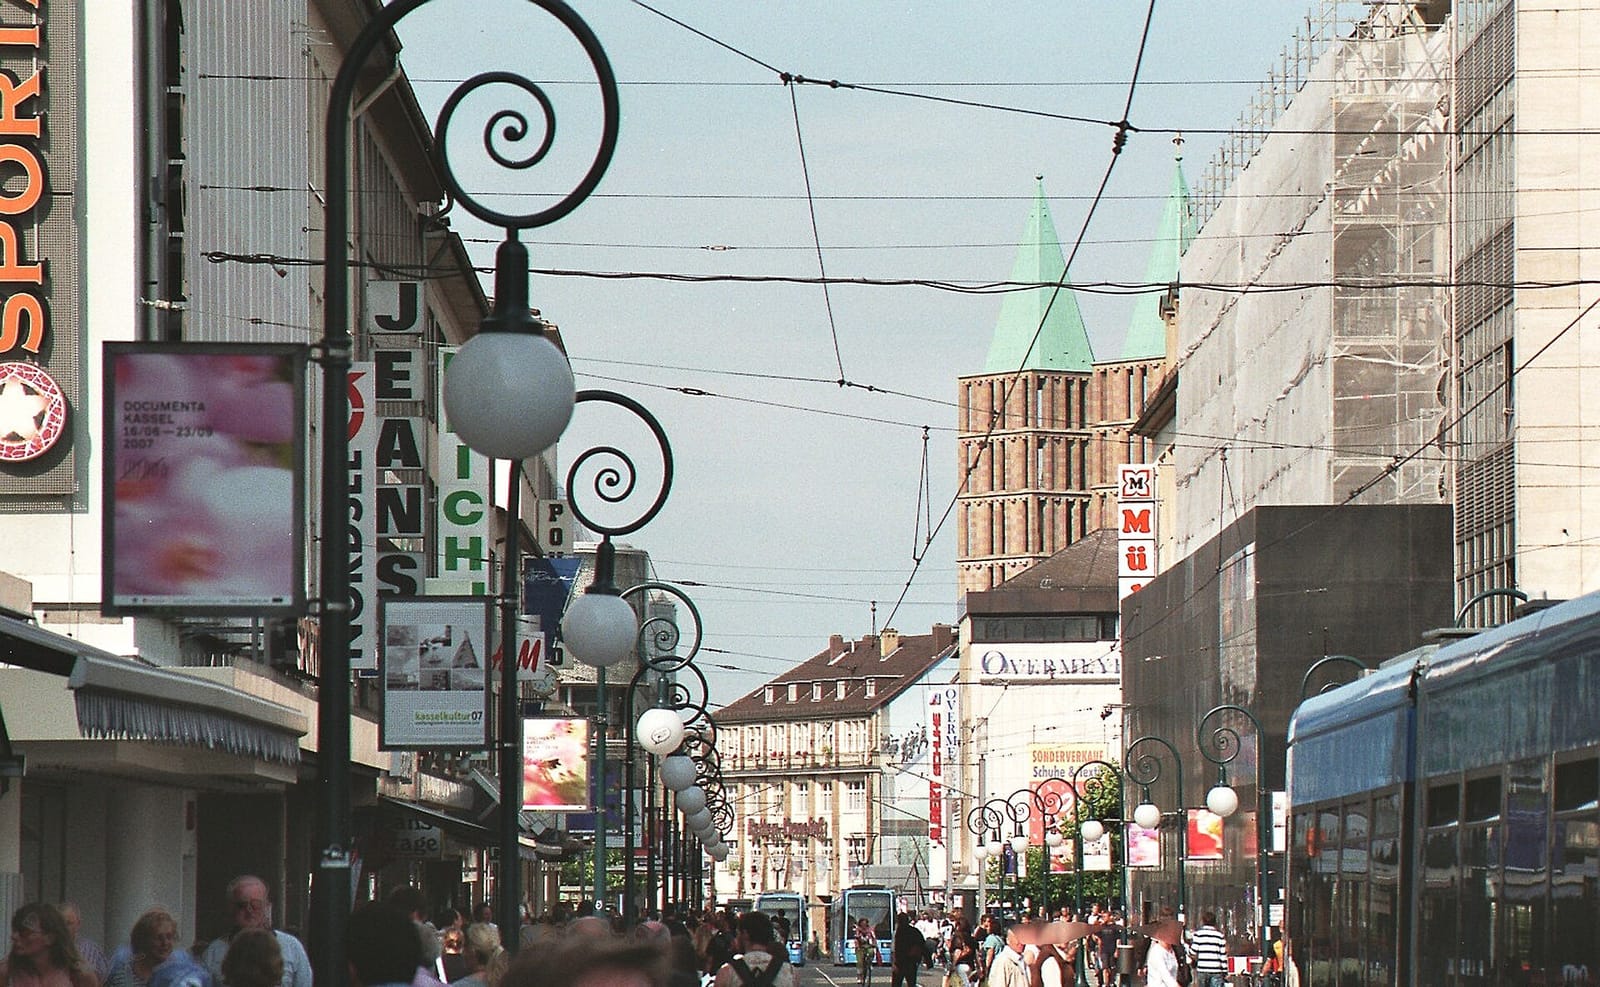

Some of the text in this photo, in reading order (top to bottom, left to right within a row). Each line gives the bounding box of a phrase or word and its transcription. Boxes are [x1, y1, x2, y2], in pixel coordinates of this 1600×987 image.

[124, 401, 206, 412] DOCUMENTA
[124, 414, 175, 424] KASSEL
[124, 438, 155, 449] 2007
[374, 283, 423, 595] JEANS
[1122, 509, 1152, 592] Mü
[1032, 750, 1104, 763] SONDERVERKAUF
[1033, 765, 1066, 778] Schuhe
